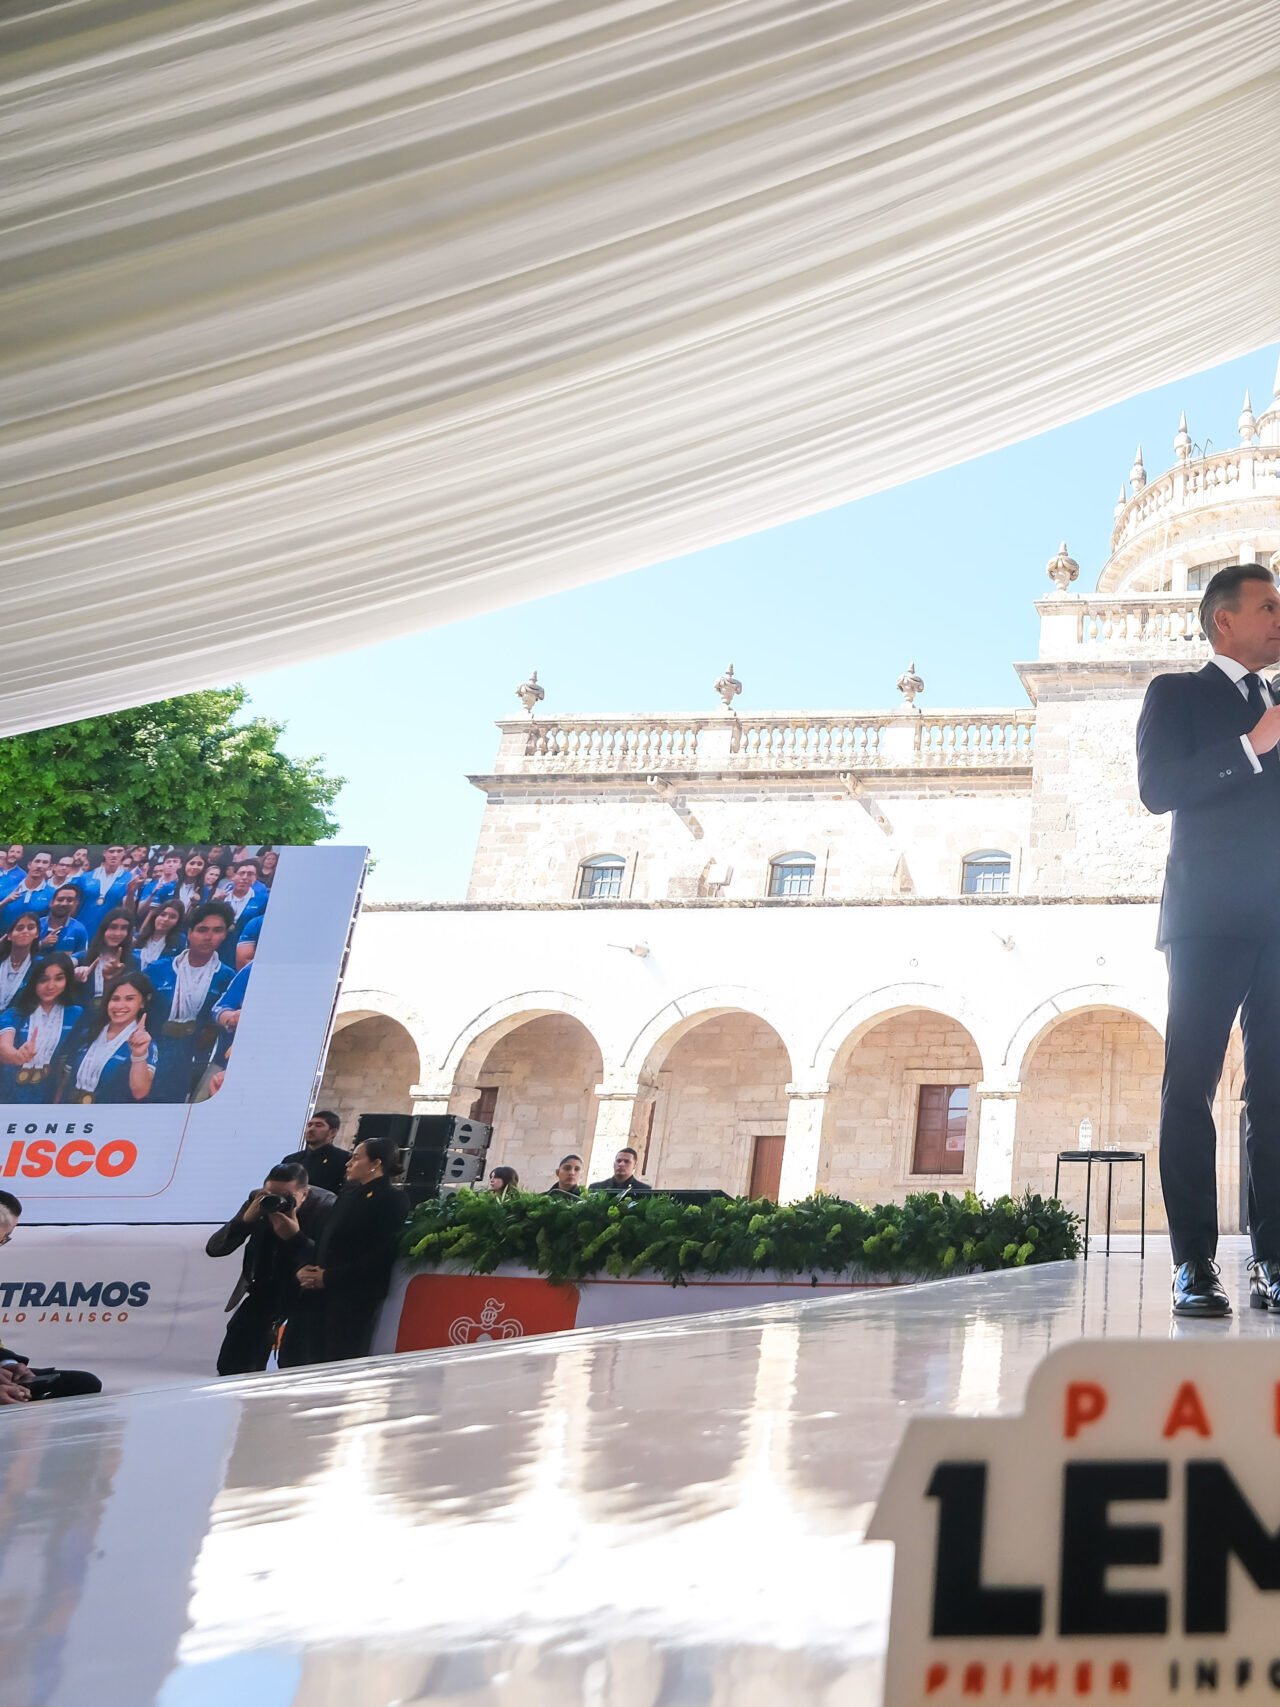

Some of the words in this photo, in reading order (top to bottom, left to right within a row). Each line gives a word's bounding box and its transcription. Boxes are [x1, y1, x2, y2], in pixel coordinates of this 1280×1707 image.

[6, 1122, 94, 1135] EONES
[0, 1139, 138, 1178] ISCO
[2, 1312, 27, 1323] LO
[38, 1311, 129, 1323] JALISCO
[924, 1658, 1133, 1697] PRIMER
